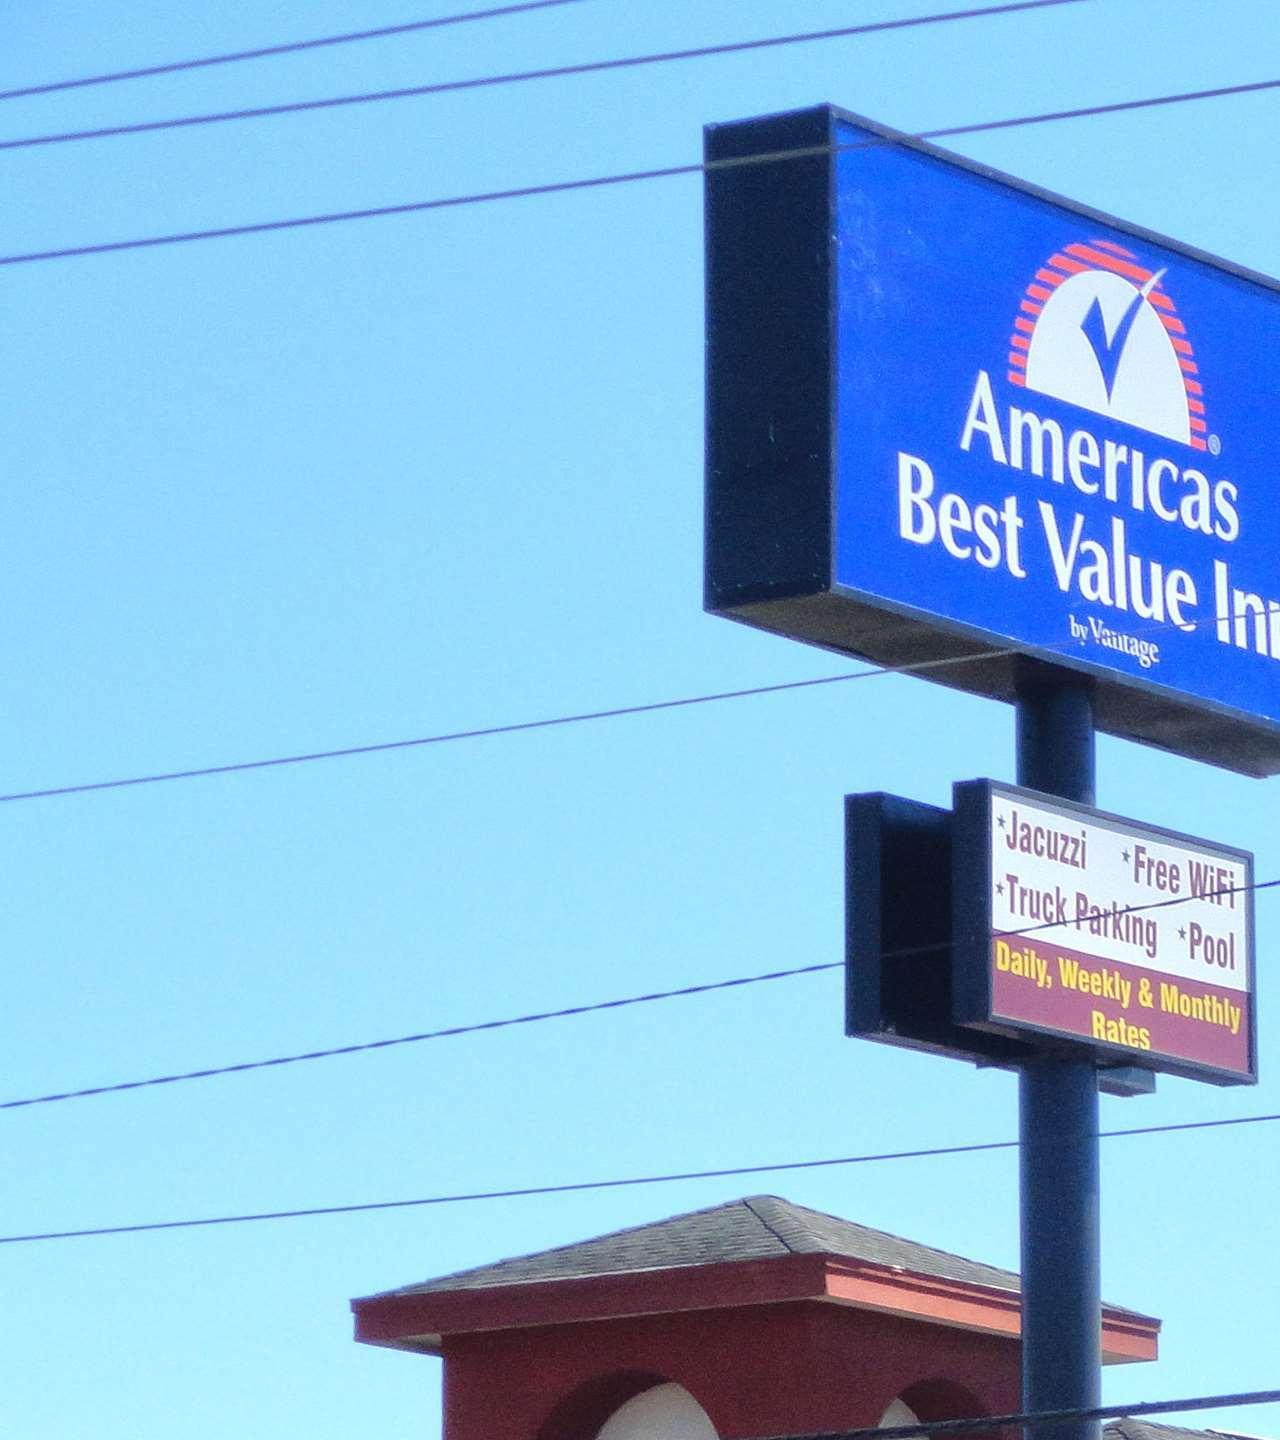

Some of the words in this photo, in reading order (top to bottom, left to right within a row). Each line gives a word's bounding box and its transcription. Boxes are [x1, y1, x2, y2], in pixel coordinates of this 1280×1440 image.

[960, 370, 1239, 541] Americas
[898, 451, 1026, 579] Best
[1038, 499, 1197, 631] Value
[1069, 614, 1088, 646] by
[1088, 616, 1160, 668] Vantage
[1006, 811, 1087, 870] Jacuzzi
[1133, 845, 1181, 894] Free
[1188, 859, 1235, 909] WiFi
[1006, 873, 1067, 927] Truck
[1076, 891, 1158, 958] Parking
[1190, 921, 1236, 970] Pool
[995, 940, 1052, 989] Daily,
[1057, 956, 1132, 1009] Weekly
[1138, 978, 1153, 1009] &
[1160, 982, 1242, 1034] Monthly
[1092, 1010, 1152, 1050] Rates
